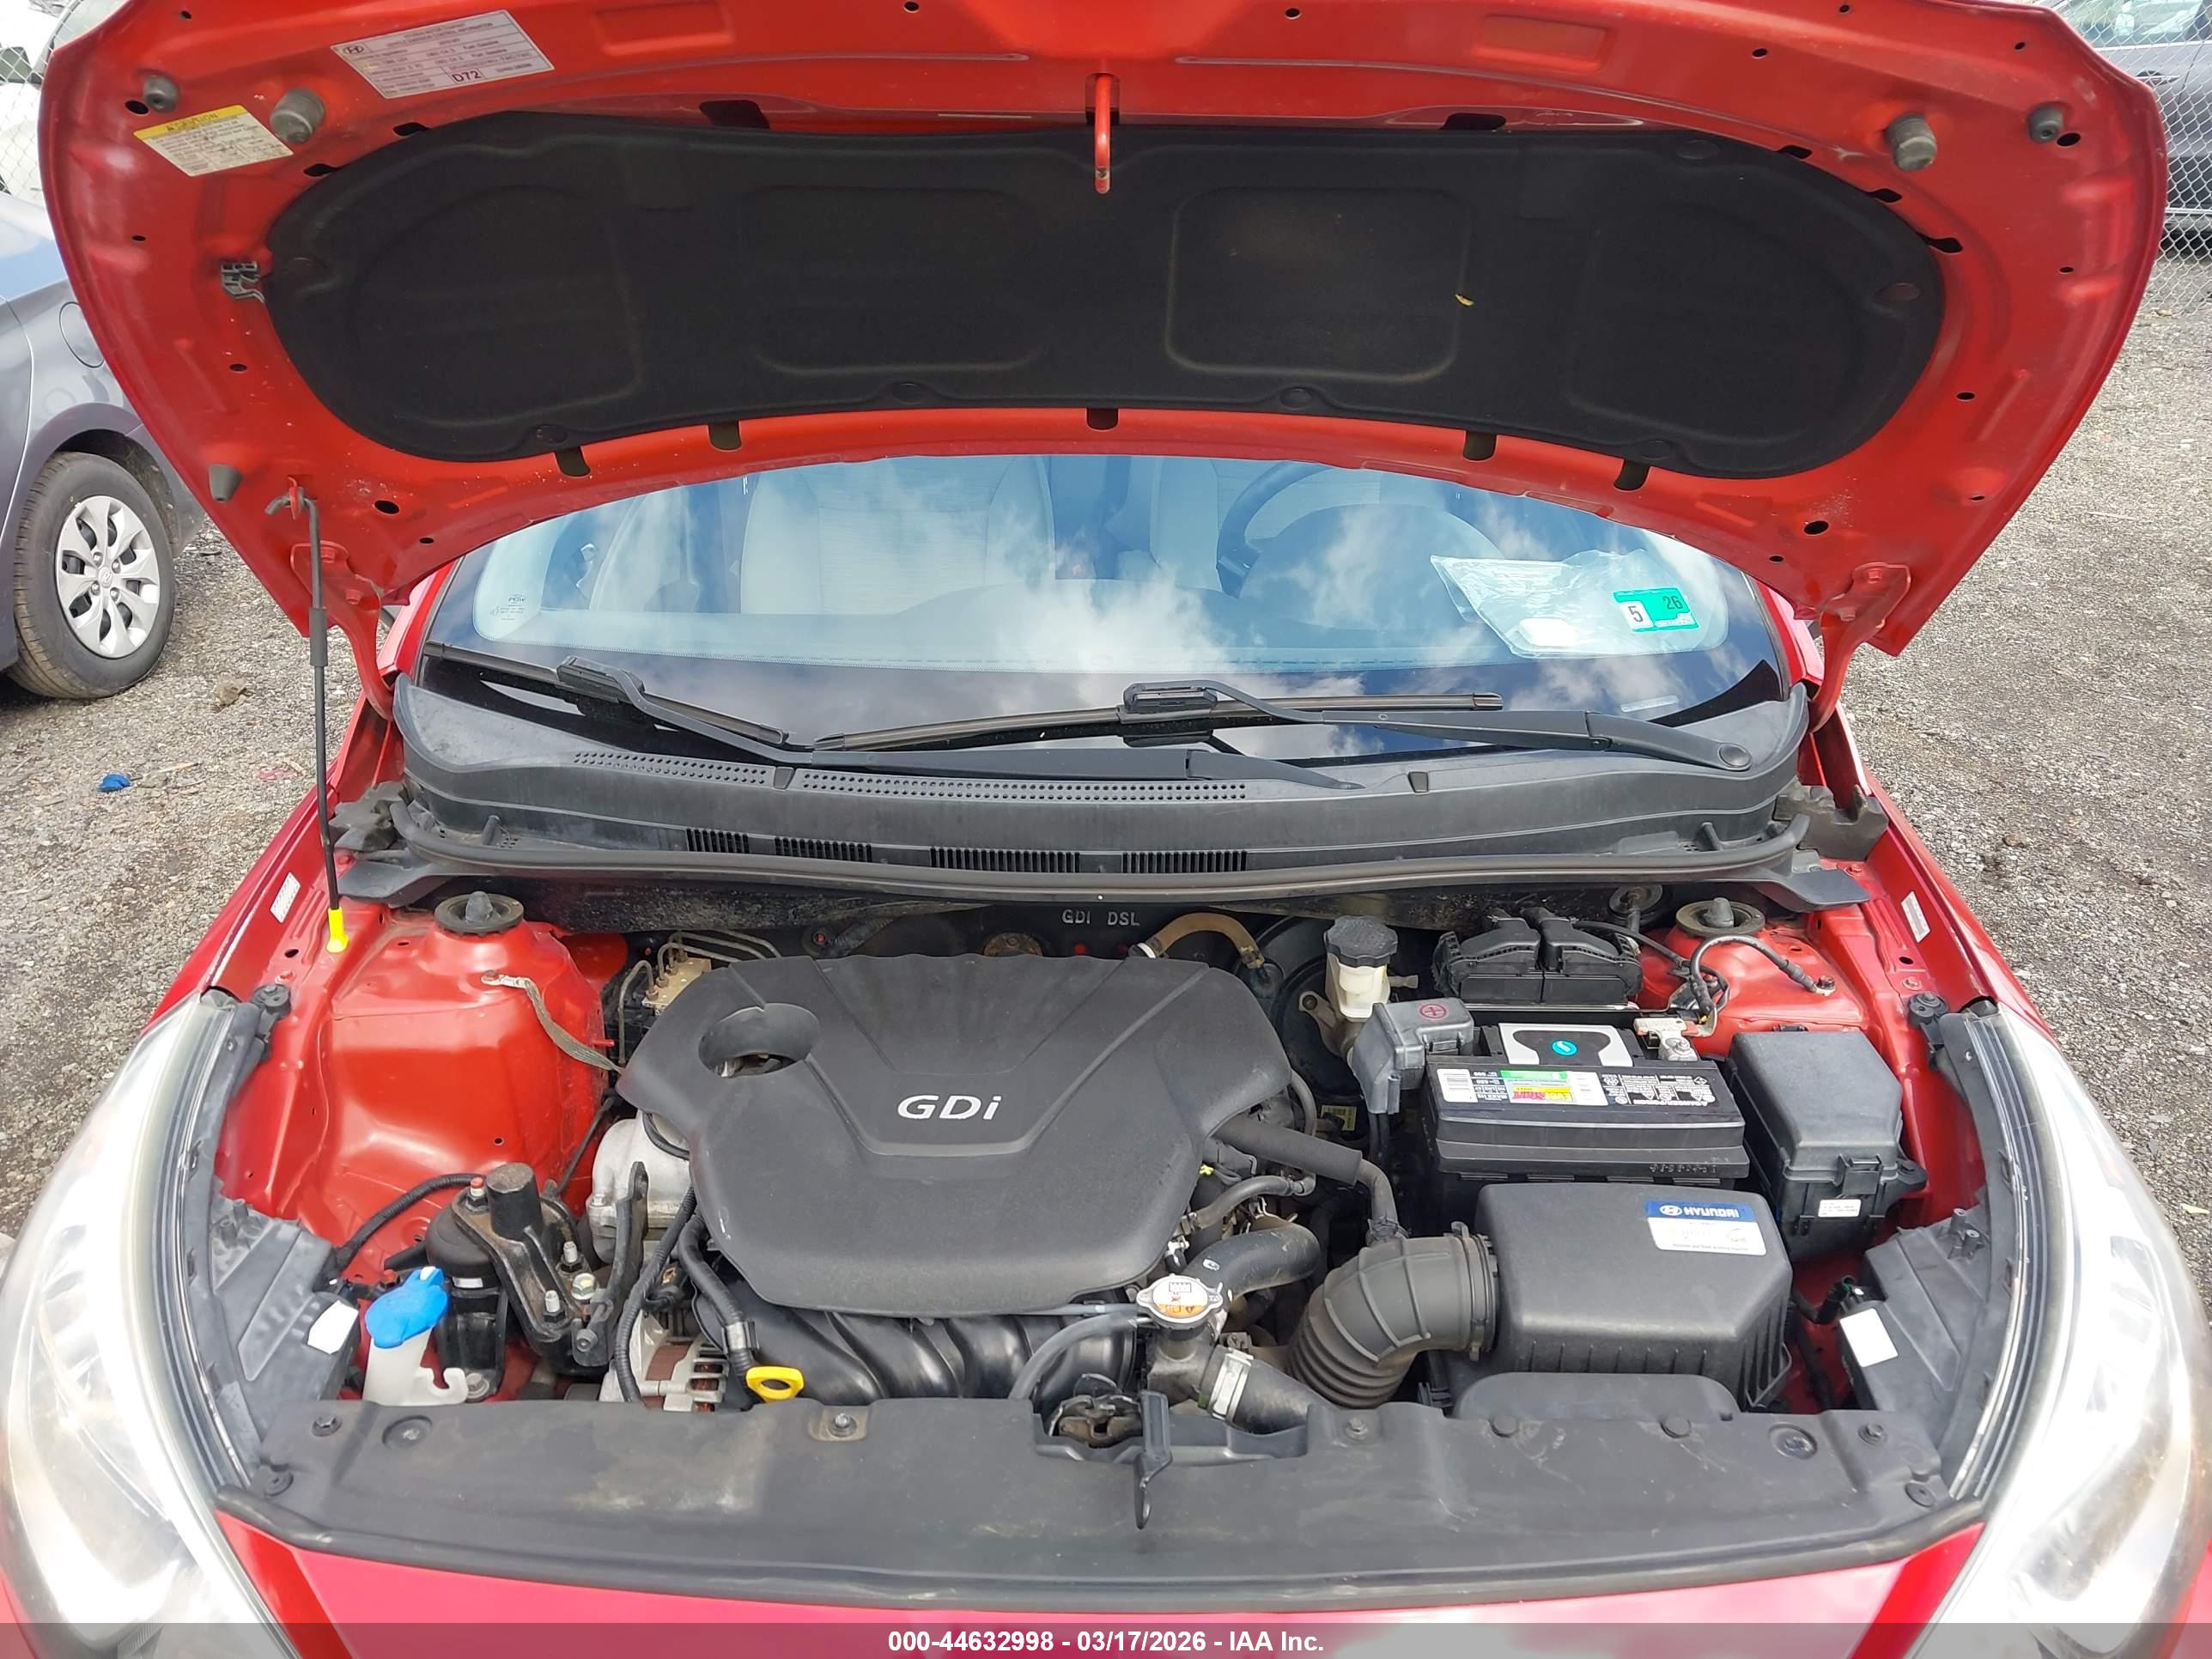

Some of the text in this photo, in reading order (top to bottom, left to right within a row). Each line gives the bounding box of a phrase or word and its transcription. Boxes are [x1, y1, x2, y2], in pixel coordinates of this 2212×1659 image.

[452, 70, 482, 82] D72
[1662, 595, 1683, 610] 26
[1628, 605, 1644, 623] 5
[1061, 908, 1140, 927] GDI DSL
[897, 1095, 1002, 1120] GDi
[1683, 1206, 1740, 1218] HYUNDAI
